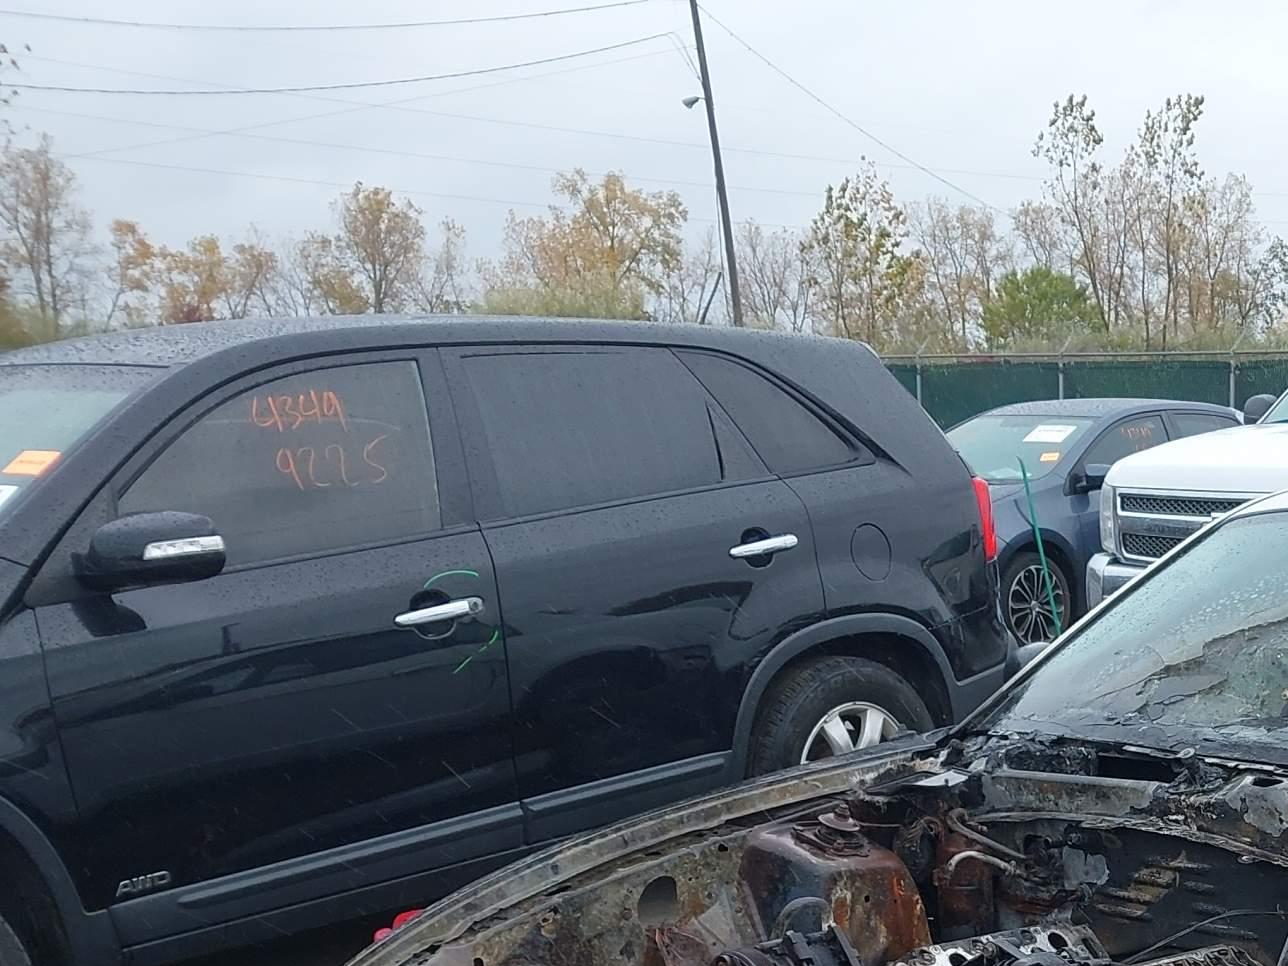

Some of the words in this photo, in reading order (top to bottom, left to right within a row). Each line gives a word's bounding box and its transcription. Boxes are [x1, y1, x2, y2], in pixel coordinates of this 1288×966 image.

[252, 390, 347, 432] 4349
[276, 434, 388, 490] 9225
[116, 871, 171, 896] AWD
